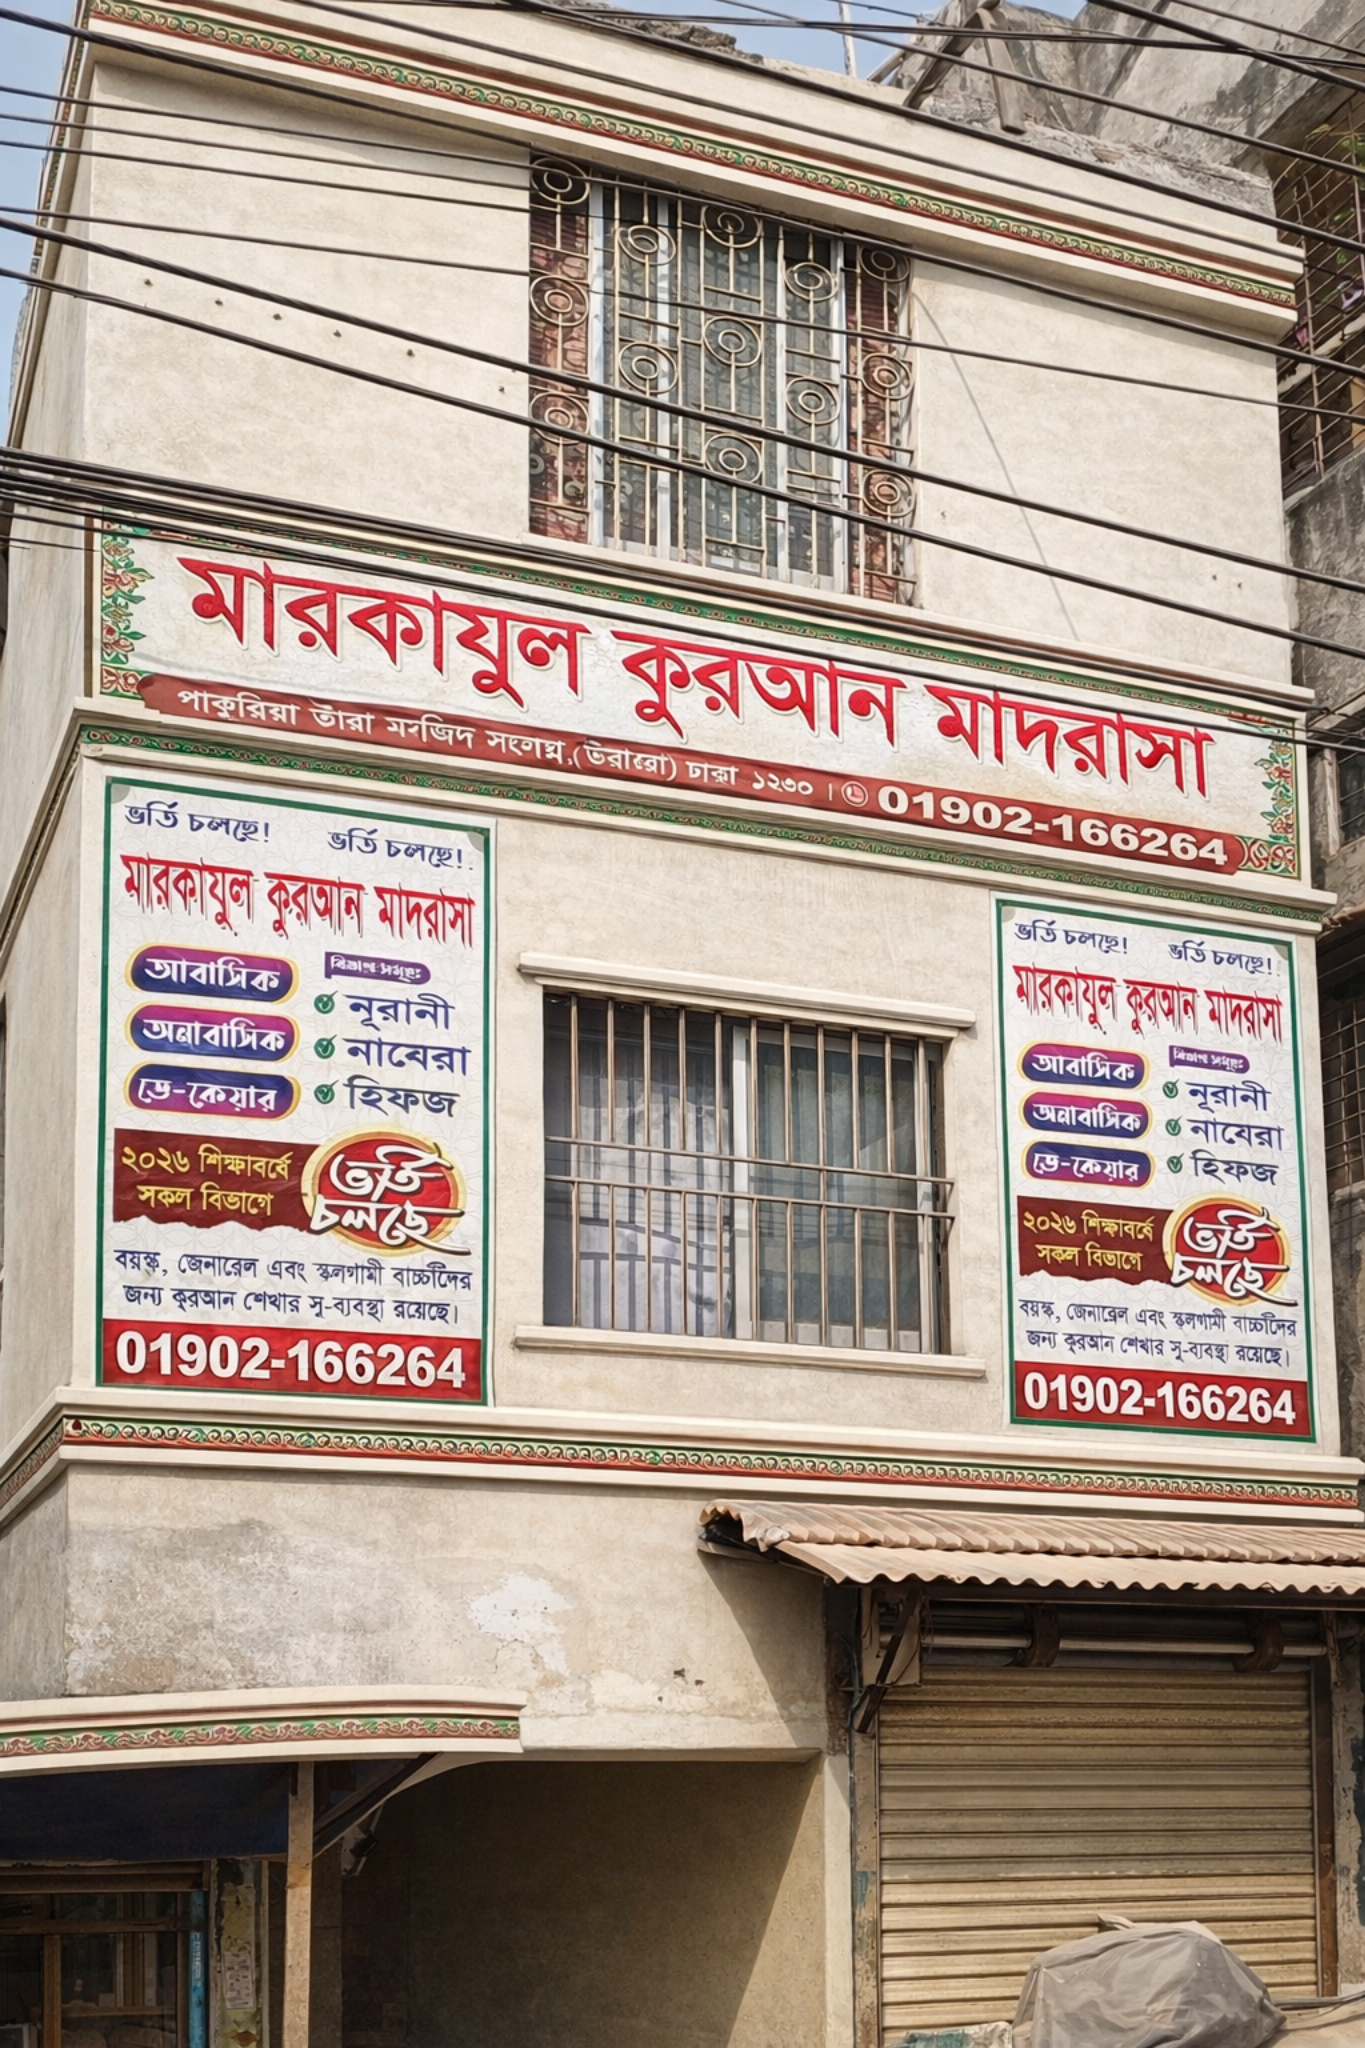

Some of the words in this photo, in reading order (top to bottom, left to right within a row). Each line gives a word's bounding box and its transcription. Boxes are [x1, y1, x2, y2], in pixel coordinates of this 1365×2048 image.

[177, 557, 591, 709] মারকাযুল
[612, 630, 907, 748] কুরআন
[925, 685, 1215, 798] মাদরাসা
[124, 800, 179, 828] ভর্তি
[189, 814, 268, 842] চলছে!
[753, 772, 812, 794] ১২৩০
[878, 785, 1228, 866] 01902-166264
[329, 828, 377, 853] ভর্তি
[386, 840, 461, 868] চলছে!
[120, 856, 254, 935] মারকাযুল
[264, 872, 365, 938] কুরআন
[374, 885, 476, 946] মাদরাসা
[1015, 919, 1057, 943] ভর্তি
[1064, 930, 1126, 953] চলছে!
[145, 956, 281, 993] আবাসিক
[1169, 939, 1206, 963] ভর্তি
[1212, 951, 1270, 974] চলছে!
[346, 993, 454, 1031] নূরানী
[1012, 963, 1117, 1034] মারকাযুল
[1123, 979, 1198, 1036] কুরআন
[1204, 988, 1283, 1042] মাদরাসা
[1032, 1053, 1135, 1082] আবাসিক
[343, 1075, 459, 1117] হিফজ
[1187, 1081, 1271, 1113] নূরানী
[122, 1147, 189, 1173] ২০২৬
[330, 1144, 454, 1201] ভর্তি
[1190, 1149, 1278, 1185] হিফজ
[137, 1186, 193, 1209] সকল
[200, 1181, 274, 1216] বিভাগে
[308, 1194, 471, 1256] চলছে
[1024, 1212, 1076, 1234] ২০২৬
[1183, 1207, 1281, 1258] ভর্তি
[268, 1261, 306, 1281] এবং
[1036, 1245, 1081, 1265] সকল
[1170, 1252, 1298, 1307] চলছে
[123, 1285, 163, 1305] জন্য
[244, 1292, 301, 1312] শেখার
[1137, 1310, 1165, 1327] এবং
[116, 1330, 466, 1389] 01902-166264
[1026, 1331, 1056, 1346] জন্য
[1121, 1337, 1164, 1355] শেখার
[1024, 1371, 1296, 1425] 01902-166264
